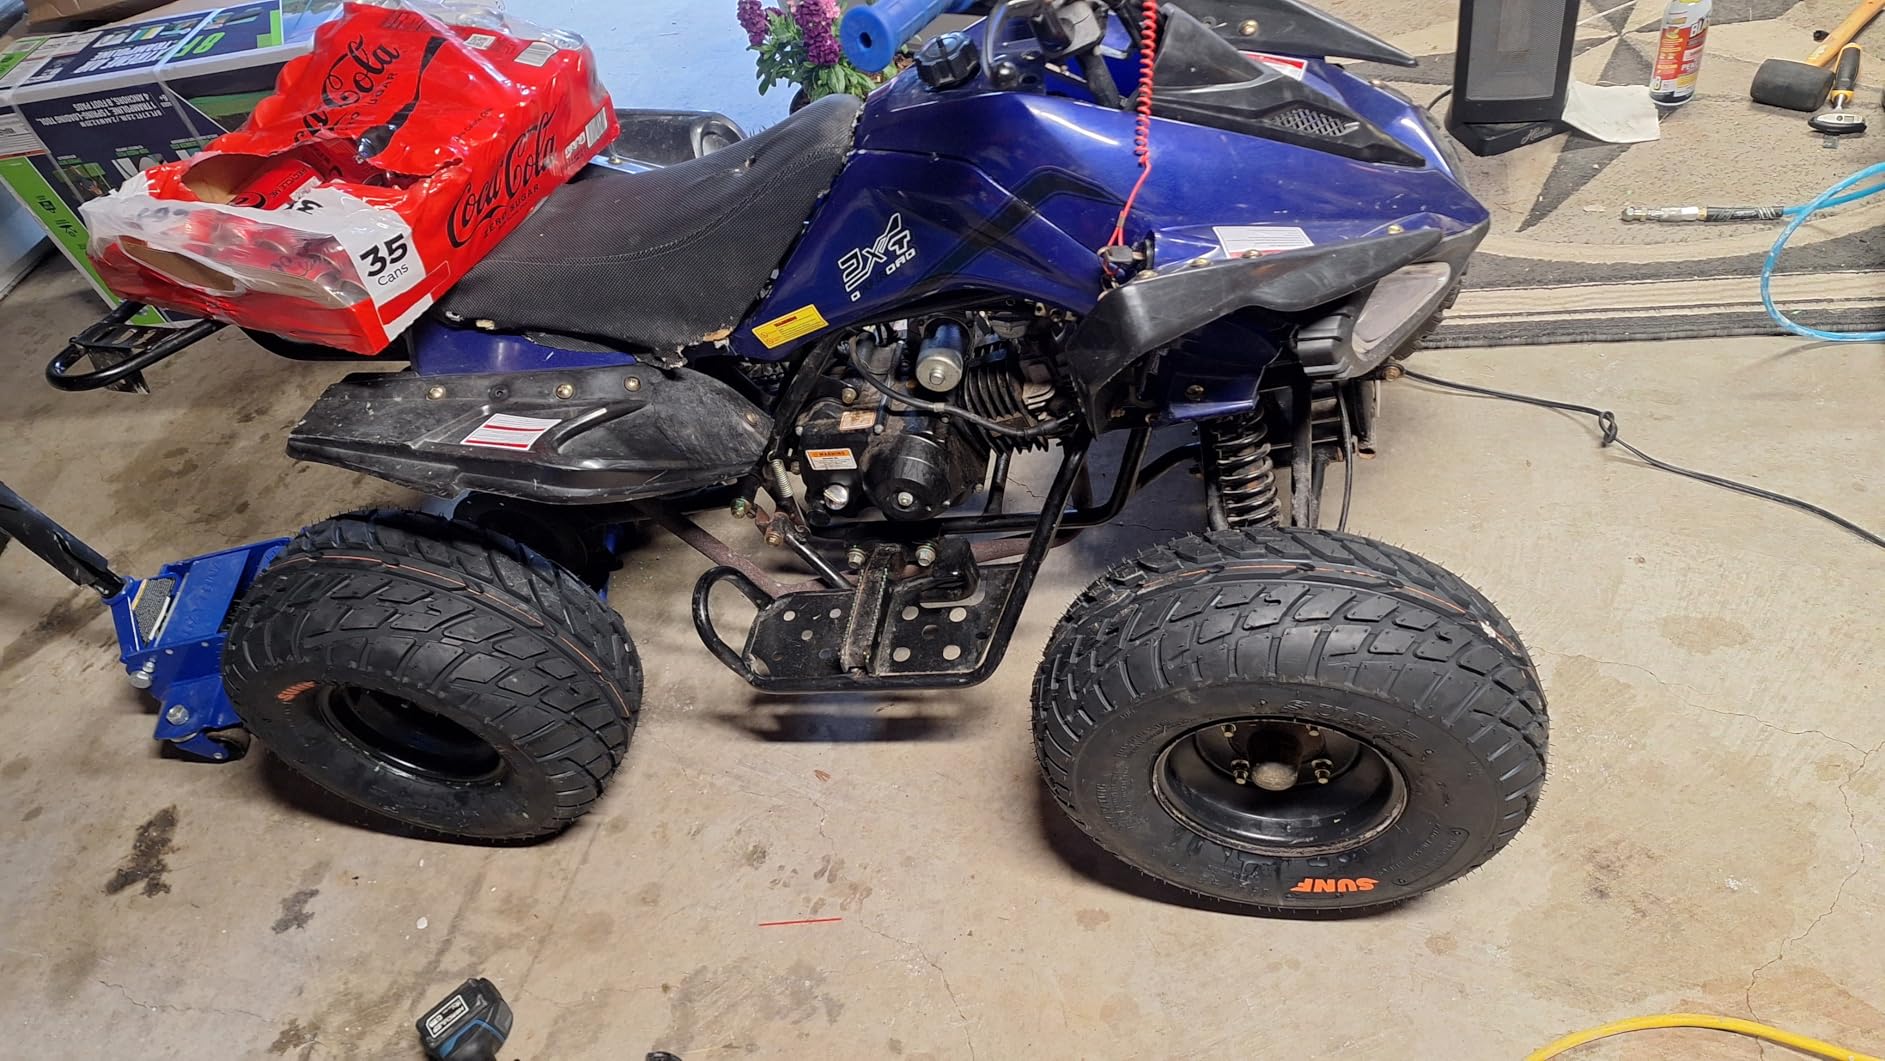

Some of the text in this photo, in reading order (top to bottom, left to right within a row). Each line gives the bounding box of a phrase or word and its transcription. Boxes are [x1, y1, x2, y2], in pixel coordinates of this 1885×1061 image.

[160, 32, 226, 59] 8 F
[483, 183, 540, 239] ZERO SUGAR
[360, 233, 408, 277] 35
[377, 263, 409, 285] Cans
